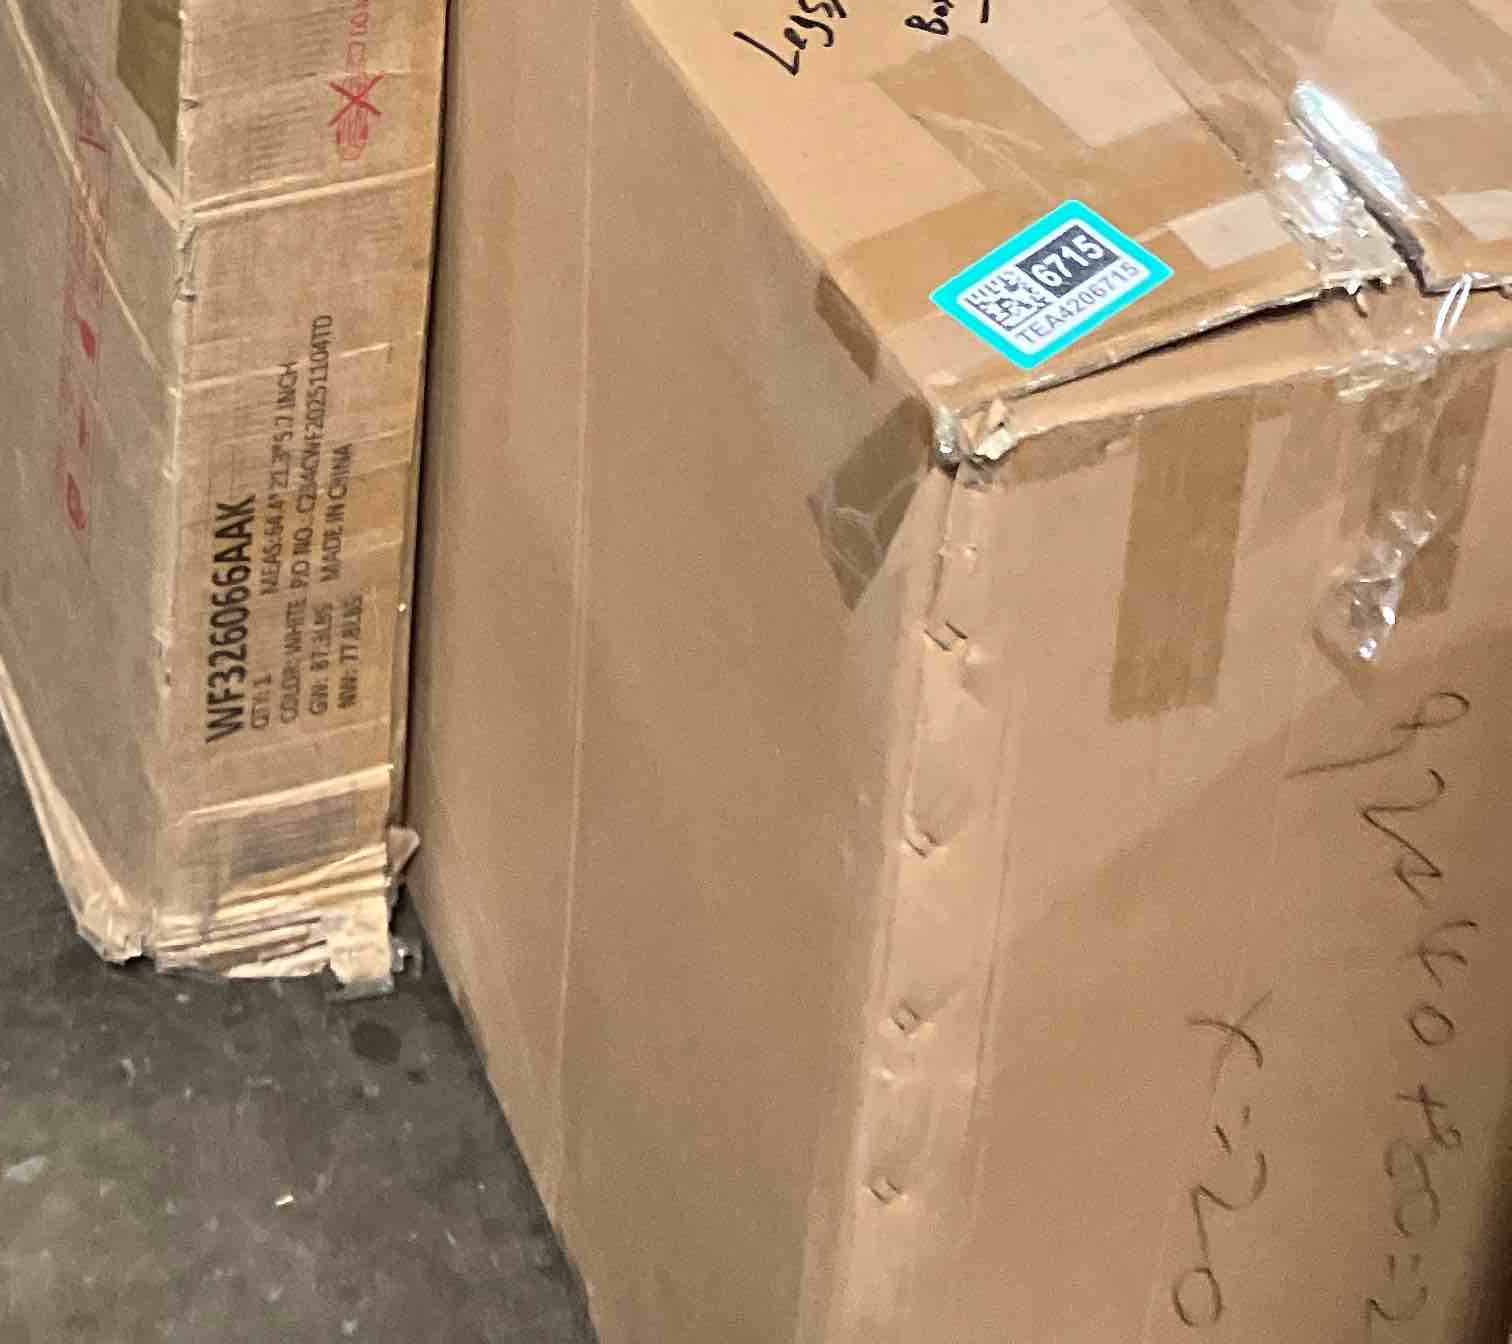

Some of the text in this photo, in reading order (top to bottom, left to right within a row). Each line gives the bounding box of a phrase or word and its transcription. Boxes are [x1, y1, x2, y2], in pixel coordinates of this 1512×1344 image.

[1030, 233, 1105, 288] 6715
[1015, 260, 1140, 344] TEA4206715
[329, 442, 354, 499] CHINA
[204, 494, 257, 744] WF326066AAK
